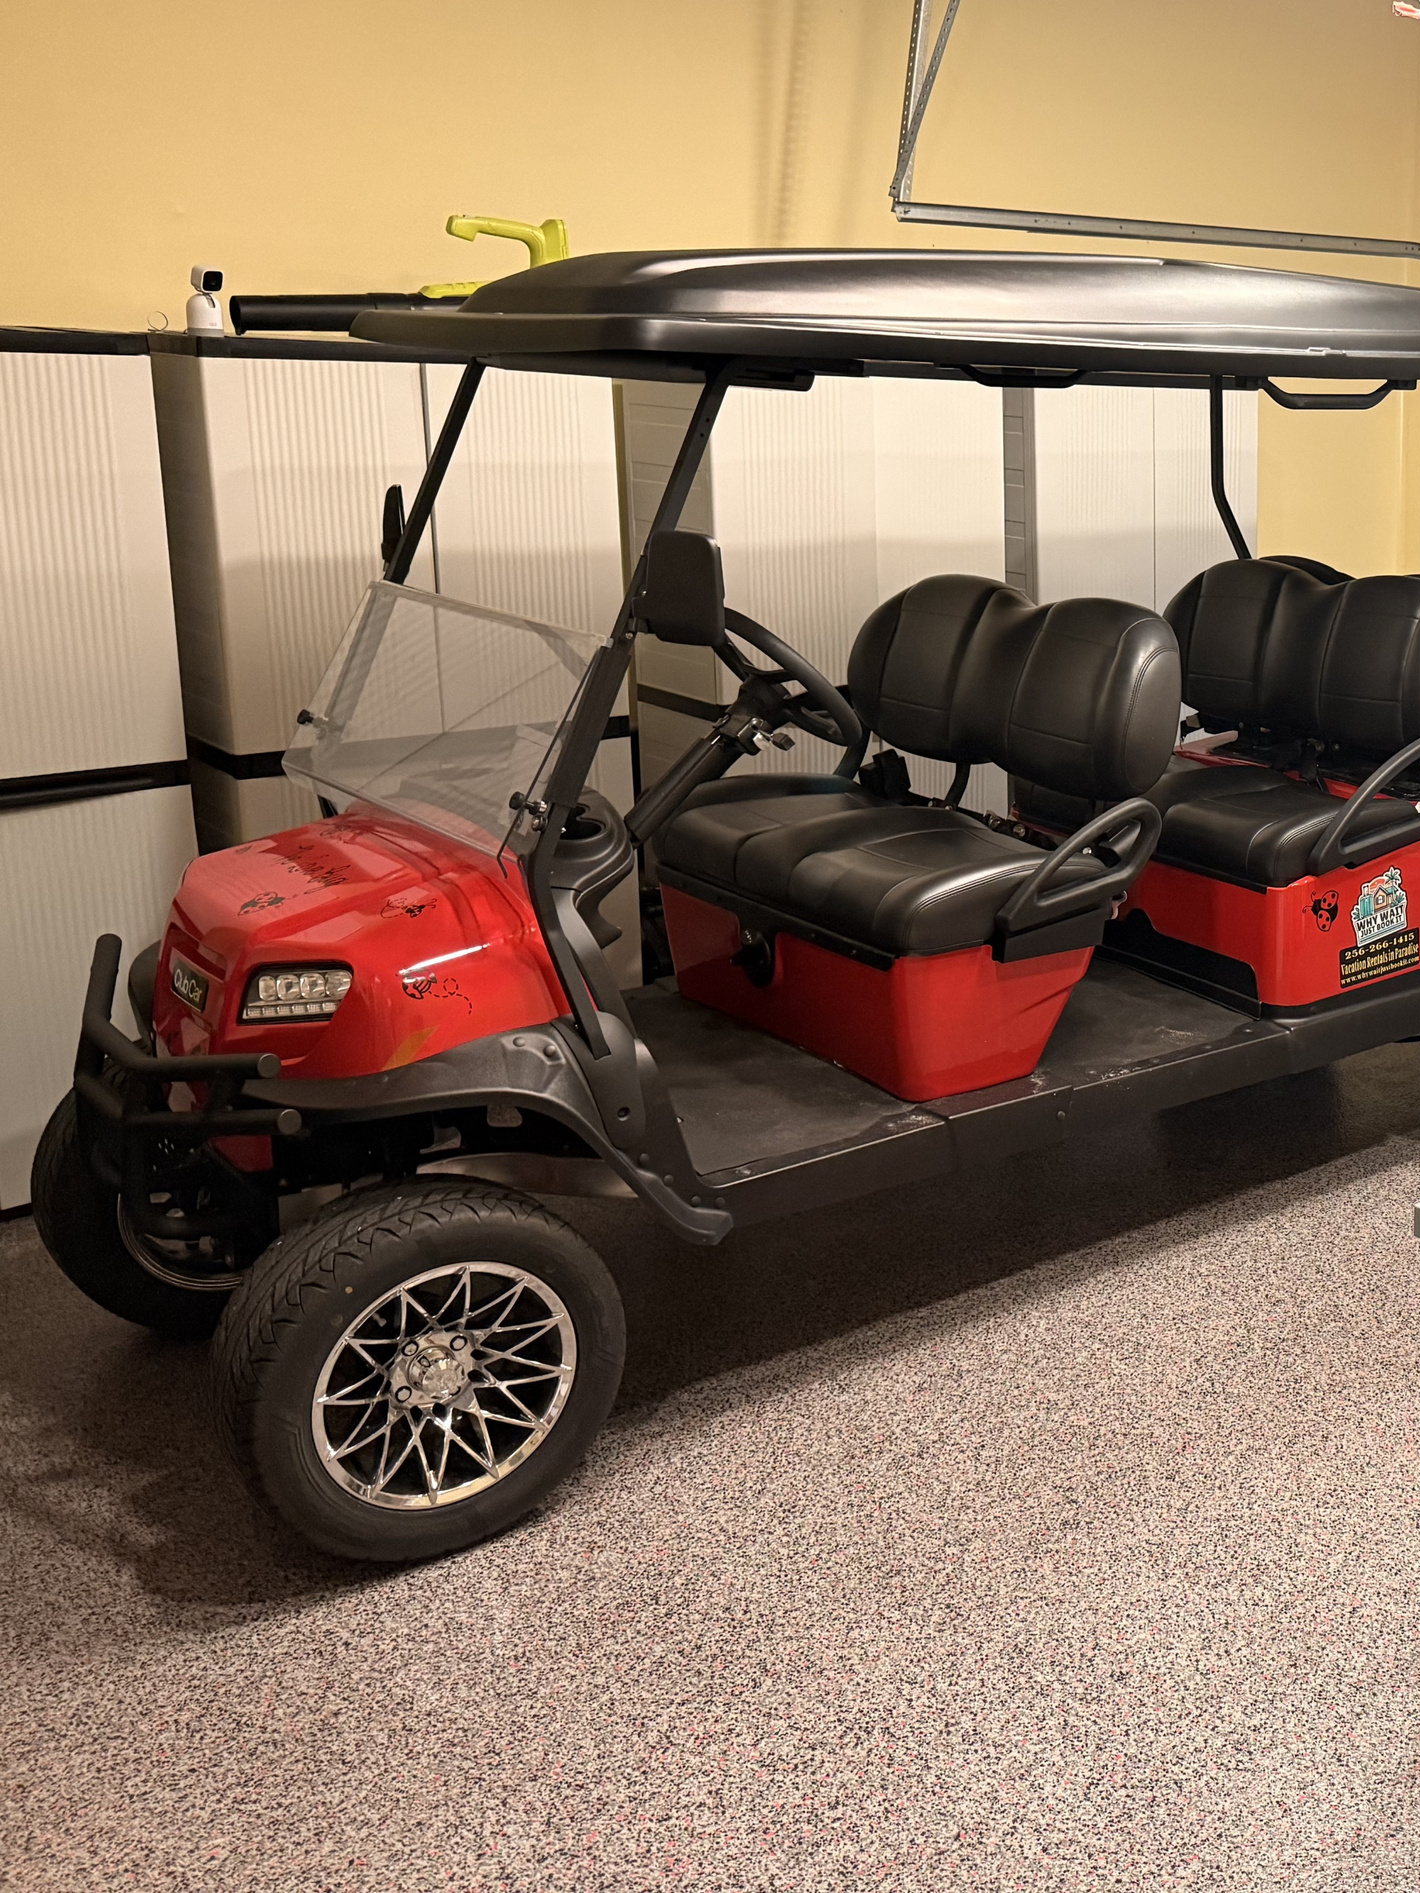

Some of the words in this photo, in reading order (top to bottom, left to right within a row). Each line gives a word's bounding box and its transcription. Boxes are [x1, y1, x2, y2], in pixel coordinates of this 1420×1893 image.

[1356, 914, 1378, 931] WHY
[1380, 904, 1404, 922] WAIT
[1360, 926, 1376, 938] JUST
[1376, 917, 1395, 931] BOOK
[1395, 914, 1402, 923] IT
[1341, 958, 1367, 976] Vacation
[1366, 951, 1388, 968] Rentals
[1388, 949, 1395, 962] in
[1394, 942, 1419, 960] Paradise
[1345, 932, 1415, 960] 256-266-1415
